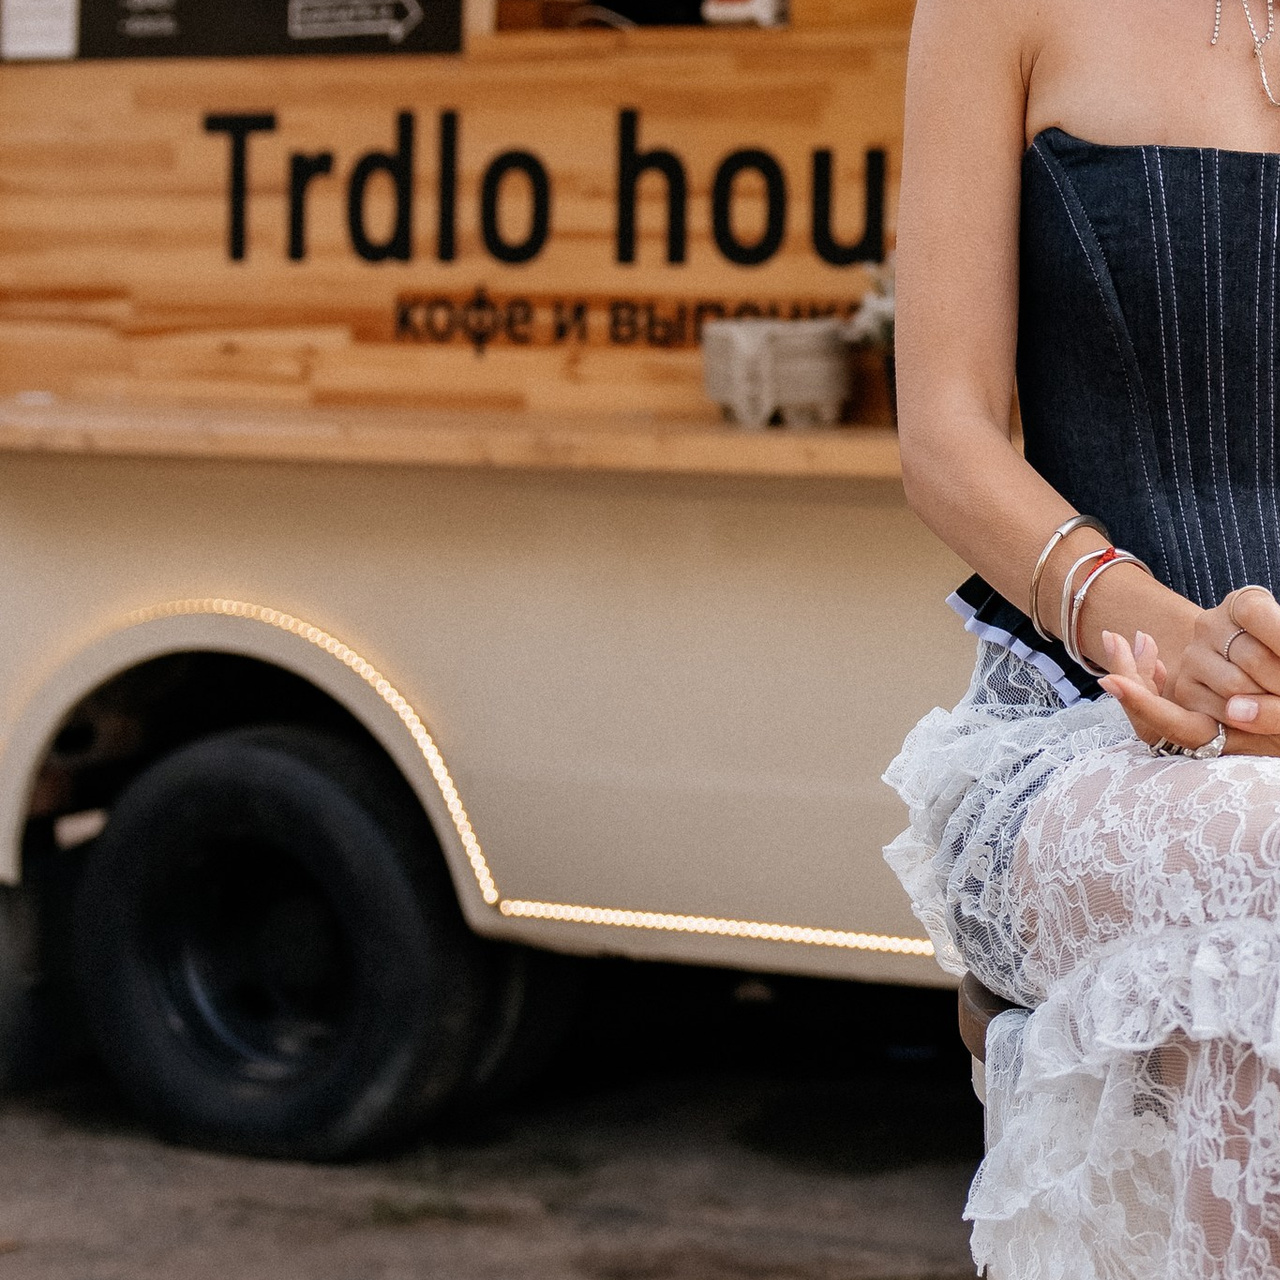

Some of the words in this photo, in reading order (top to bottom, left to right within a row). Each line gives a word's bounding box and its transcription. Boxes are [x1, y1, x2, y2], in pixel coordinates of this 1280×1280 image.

[203, 108, 551, 266] Trdlo
[615, 107, 887, 266] hou
[396, 287, 535, 358] кофе
[553, 297, 589, 341] и
